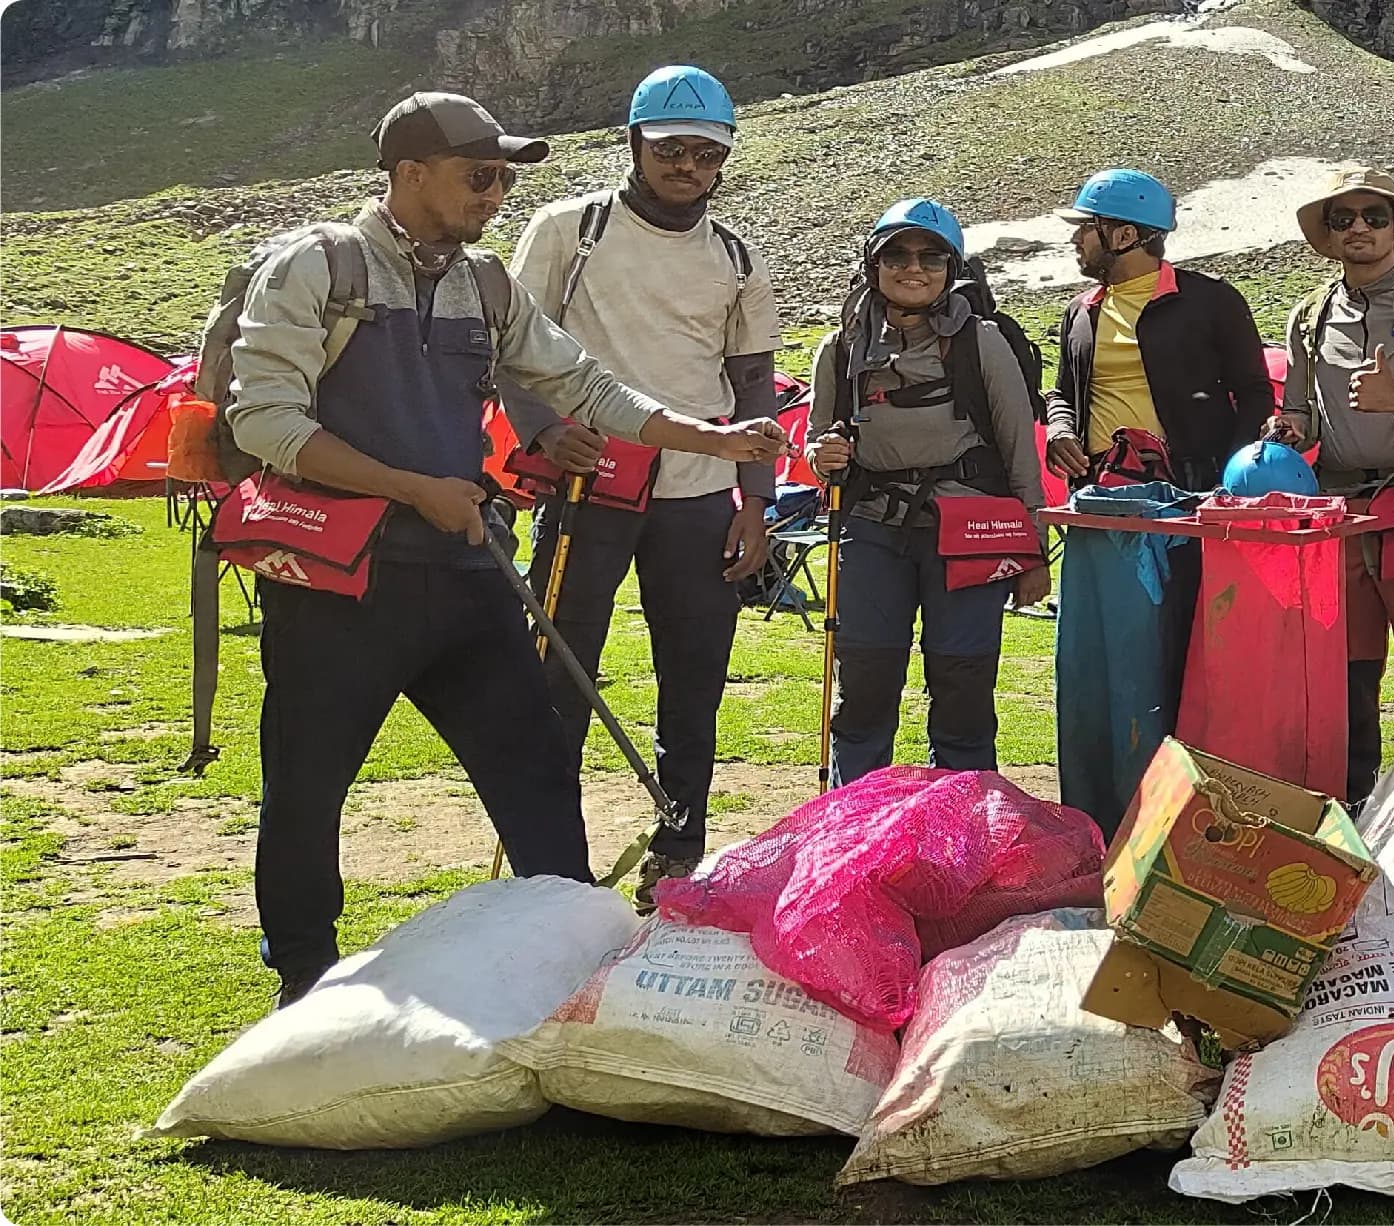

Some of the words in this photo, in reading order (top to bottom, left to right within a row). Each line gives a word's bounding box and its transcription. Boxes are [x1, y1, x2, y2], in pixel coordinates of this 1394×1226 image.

[282, 502, 328, 523] Himala
[967, 520, 990, 530] Heal
[991, 520, 1023, 530] Himala
[635, 969, 738, 1001] UTTAM
[1305, 963, 1384, 995] MACAR
[1300, 978, 1389, 1012] MACARO
[1346, 1004, 1385, 1017] INDIAN
